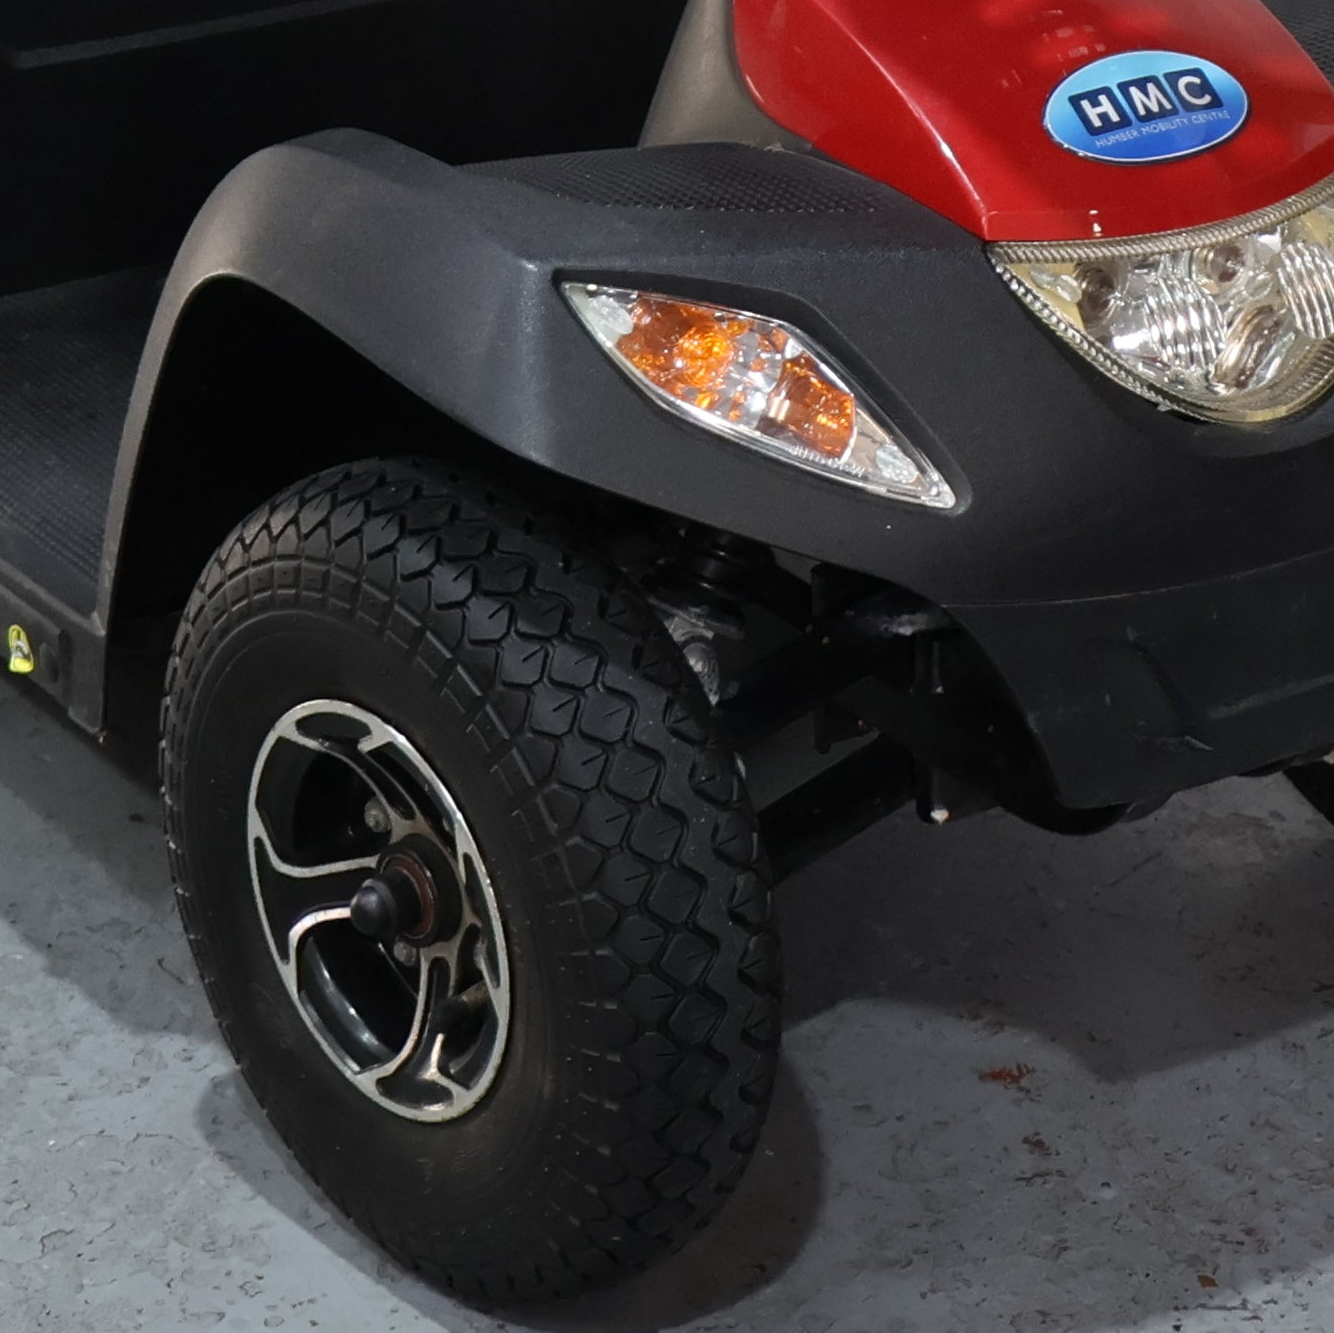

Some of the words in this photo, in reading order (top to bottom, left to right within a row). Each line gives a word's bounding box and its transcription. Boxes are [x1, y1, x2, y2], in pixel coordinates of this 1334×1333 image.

[1094, 129, 1140, 149] HUMBER
[1140, 117, 1189, 136] MOBILITY
[1191, 110, 1231, 125] CENTRE
